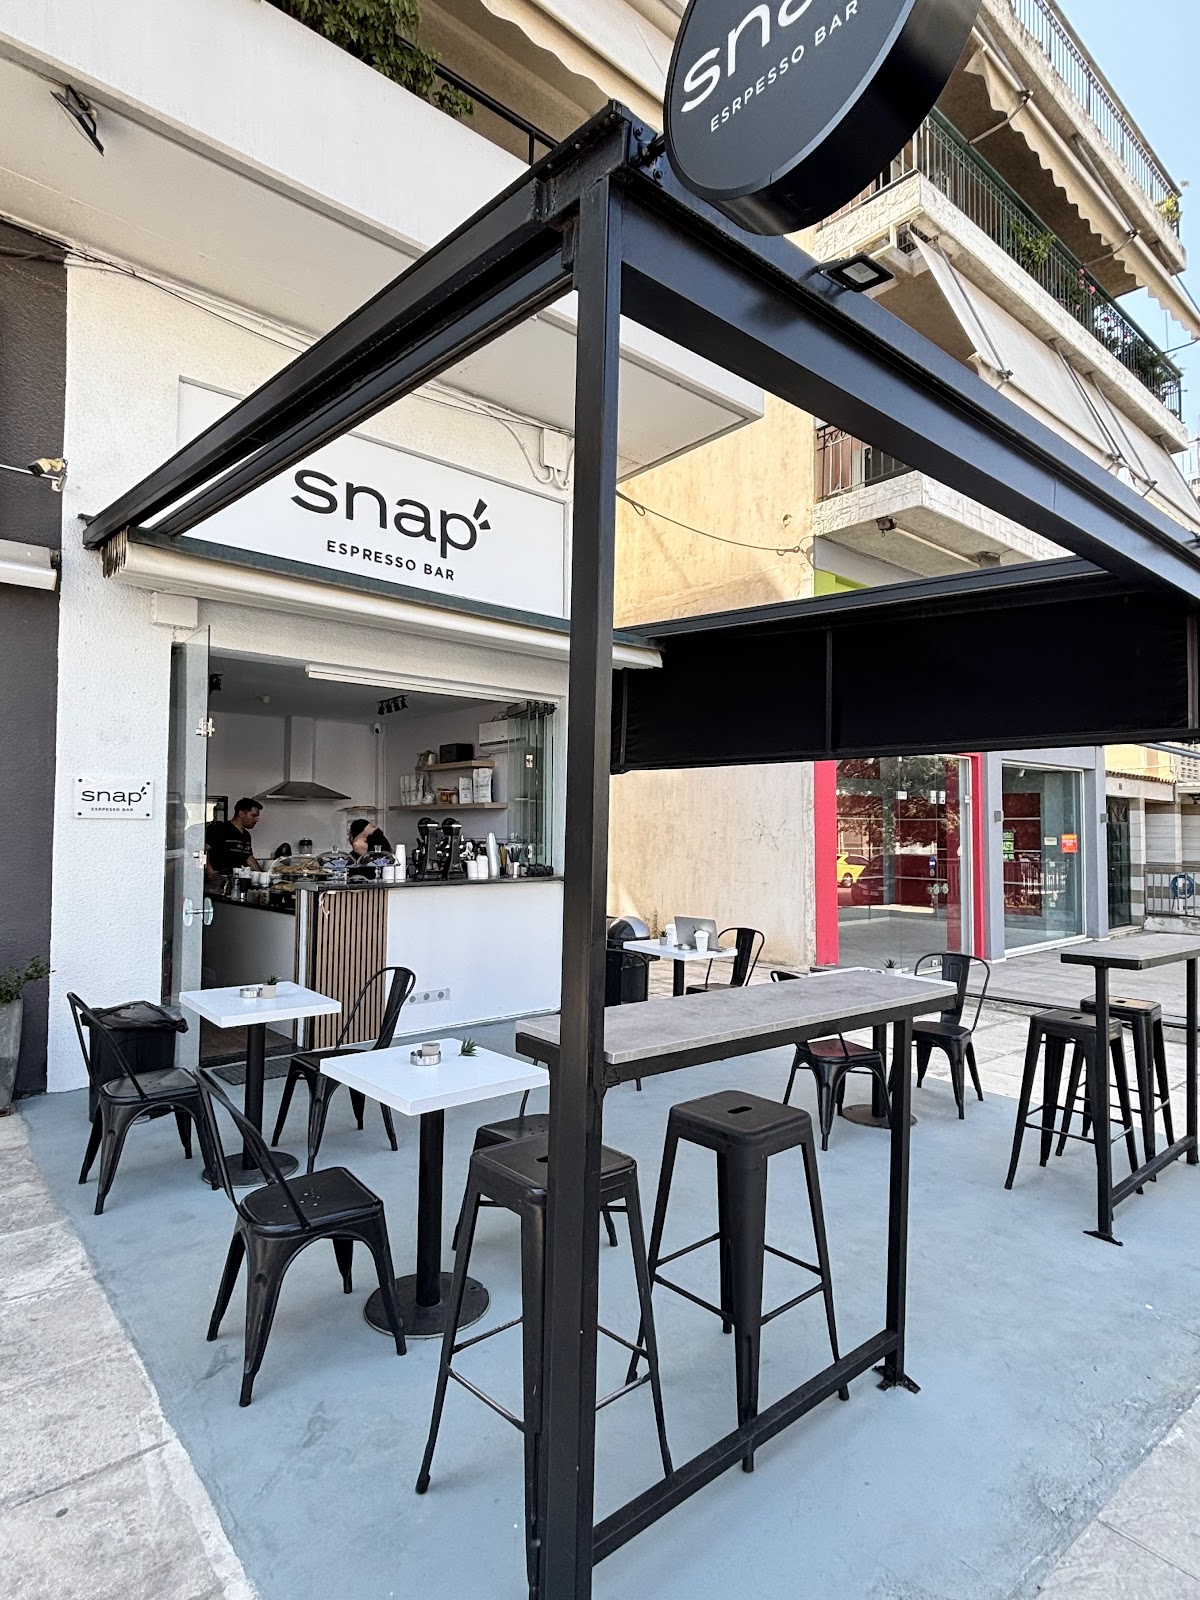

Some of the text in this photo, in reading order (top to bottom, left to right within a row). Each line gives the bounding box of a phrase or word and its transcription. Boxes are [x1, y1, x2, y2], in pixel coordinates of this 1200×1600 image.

[709, 0, 859, 133] ESRPESSO BAR
[326, 539, 456, 581] ESPRESSO BAR
[81, 790, 142, 806] snap
